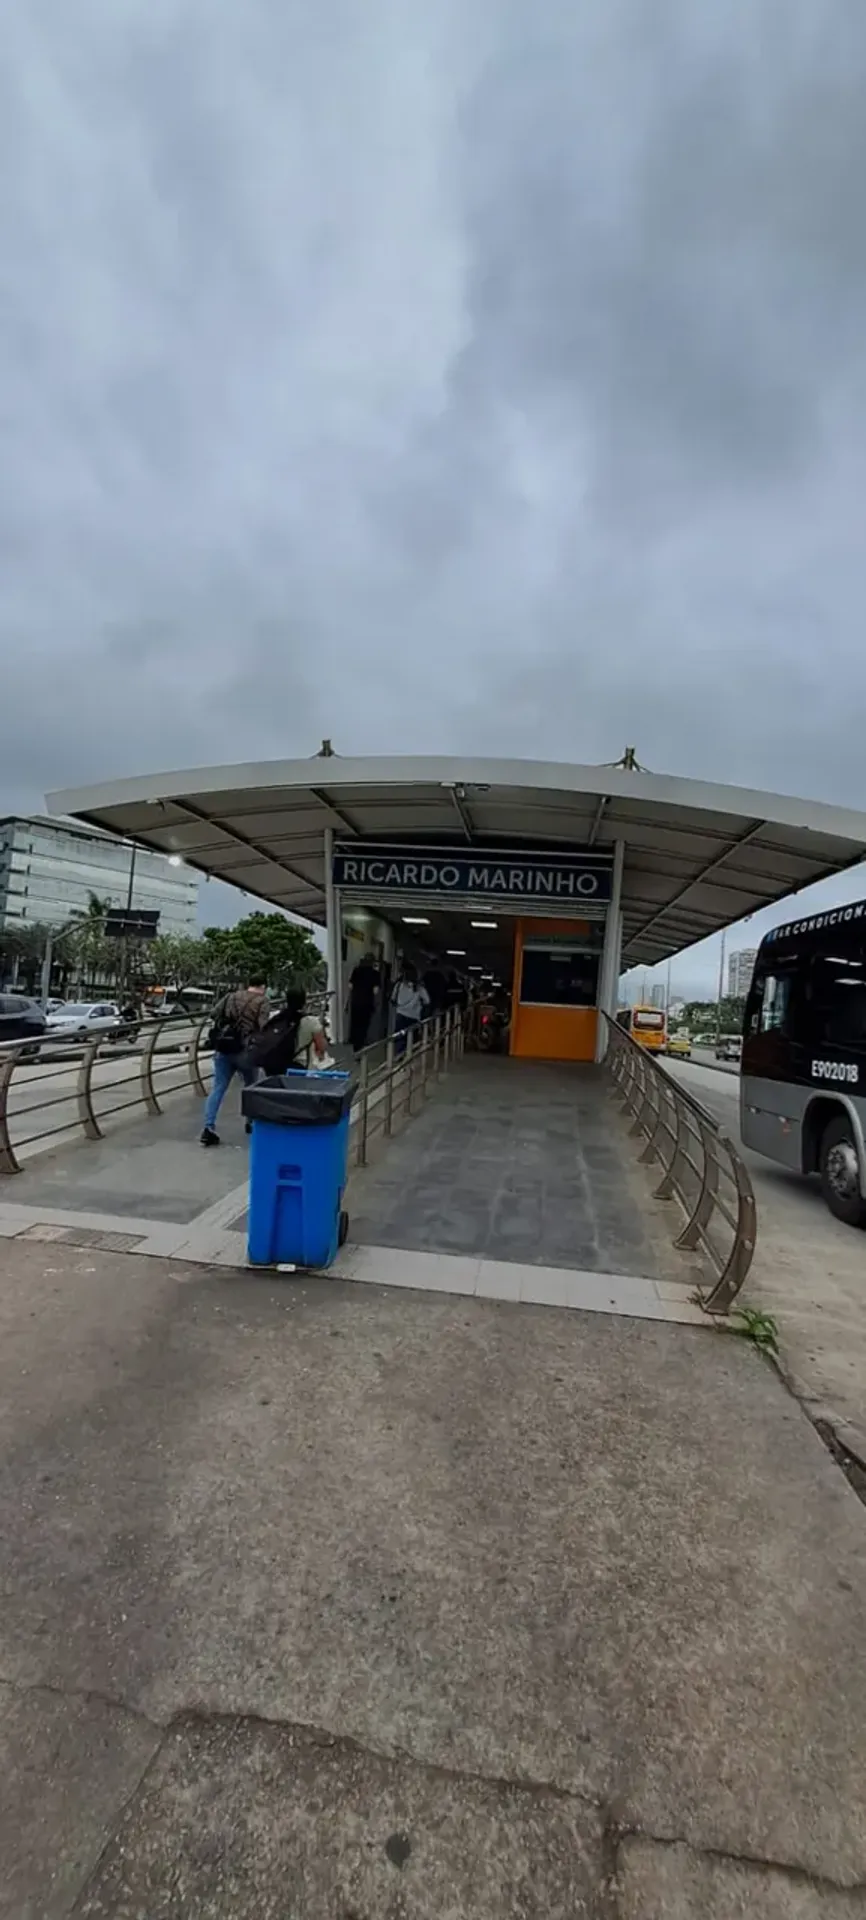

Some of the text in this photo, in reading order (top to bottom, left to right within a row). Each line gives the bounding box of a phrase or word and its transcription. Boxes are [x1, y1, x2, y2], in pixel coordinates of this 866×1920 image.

[343, 860, 598, 894] RICARDO MARINHO
[792, 904, 866, 935] CONDICION
[811, 1060, 858, 1082] E902018
